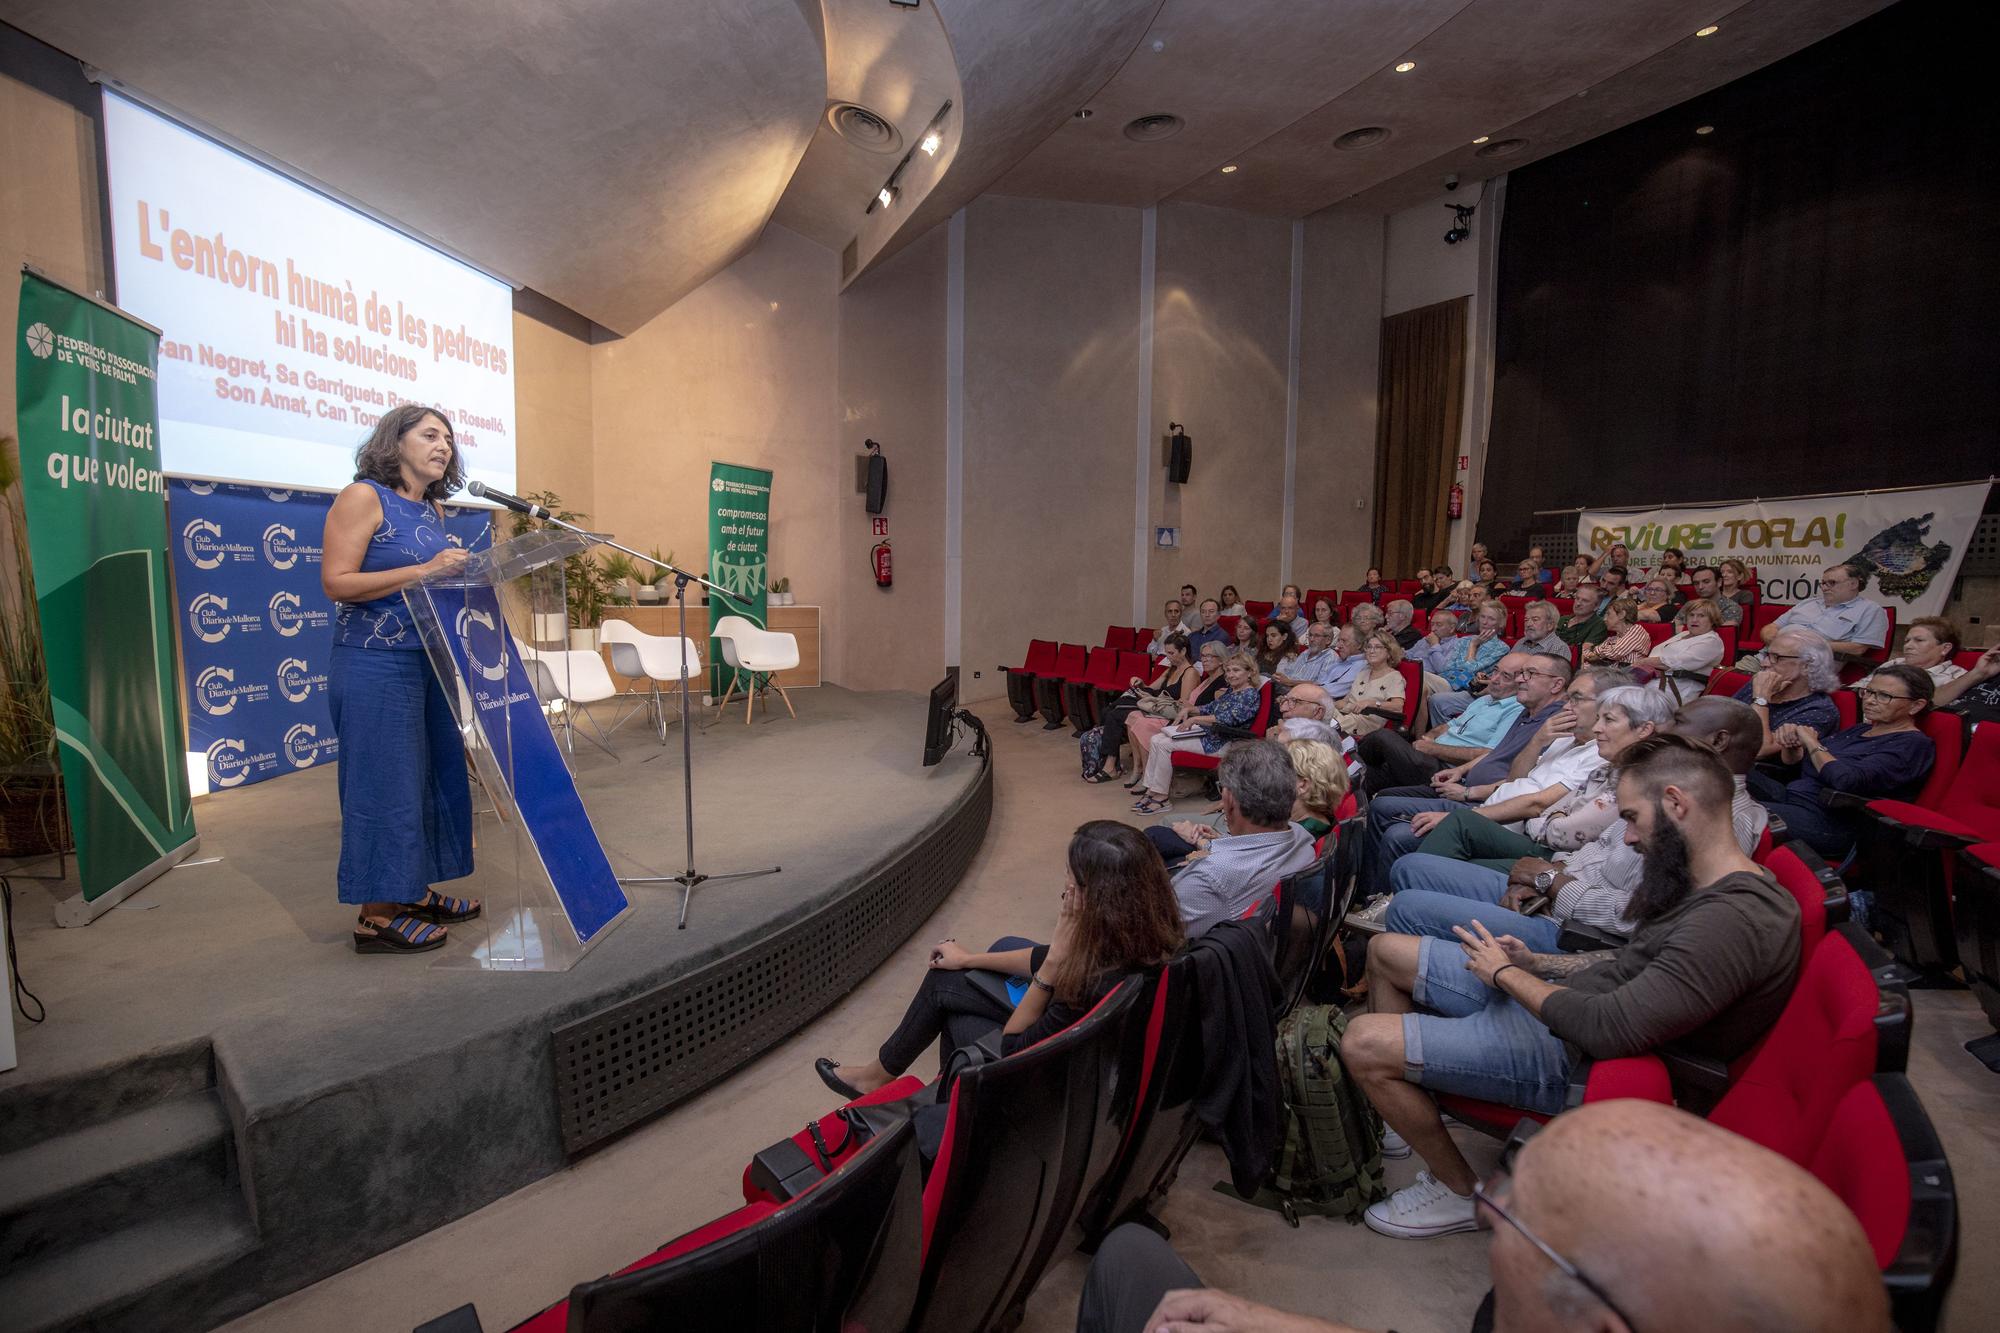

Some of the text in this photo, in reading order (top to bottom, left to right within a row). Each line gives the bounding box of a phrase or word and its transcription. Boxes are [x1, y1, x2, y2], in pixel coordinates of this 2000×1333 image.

[137, 199, 507, 375] L'entorn humà de les pedreres
[275, 309, 417, 382] hi ha solucions
[57, 349, 73, 363] DE
[102, 363, 112, 377] DE
[112, 366, 137, 385] PALMA
[158, 339, 193, 362] an
[198, 343, 271, 383] Negret,
[275, 362, 299, 386] Sa
[304, 370, 384, 406] Garrigueta
[459, 408, 506, 437] Rosselló,
[214, 376, 256, 404] Son
[260, 386, 311, 418] Amat,
[316, 398, 347, 422] Can
[61, 394, 153, 451] la ciutat
[47, 452, 163, 494] que volem
[717, 508, 767, 521] compromesos
[721, 523, 764, 538] amb el futur
[195, 535, 210, 543] Club
[727, 540, 758, 552] de ciutat
[201, 609, 216, 617] Club
[207, 682, 223, 690] Club
[475, 691, 489, 701] Club
[294, 737, 307, 746] Club
[218, 753, 234, 762] Club
